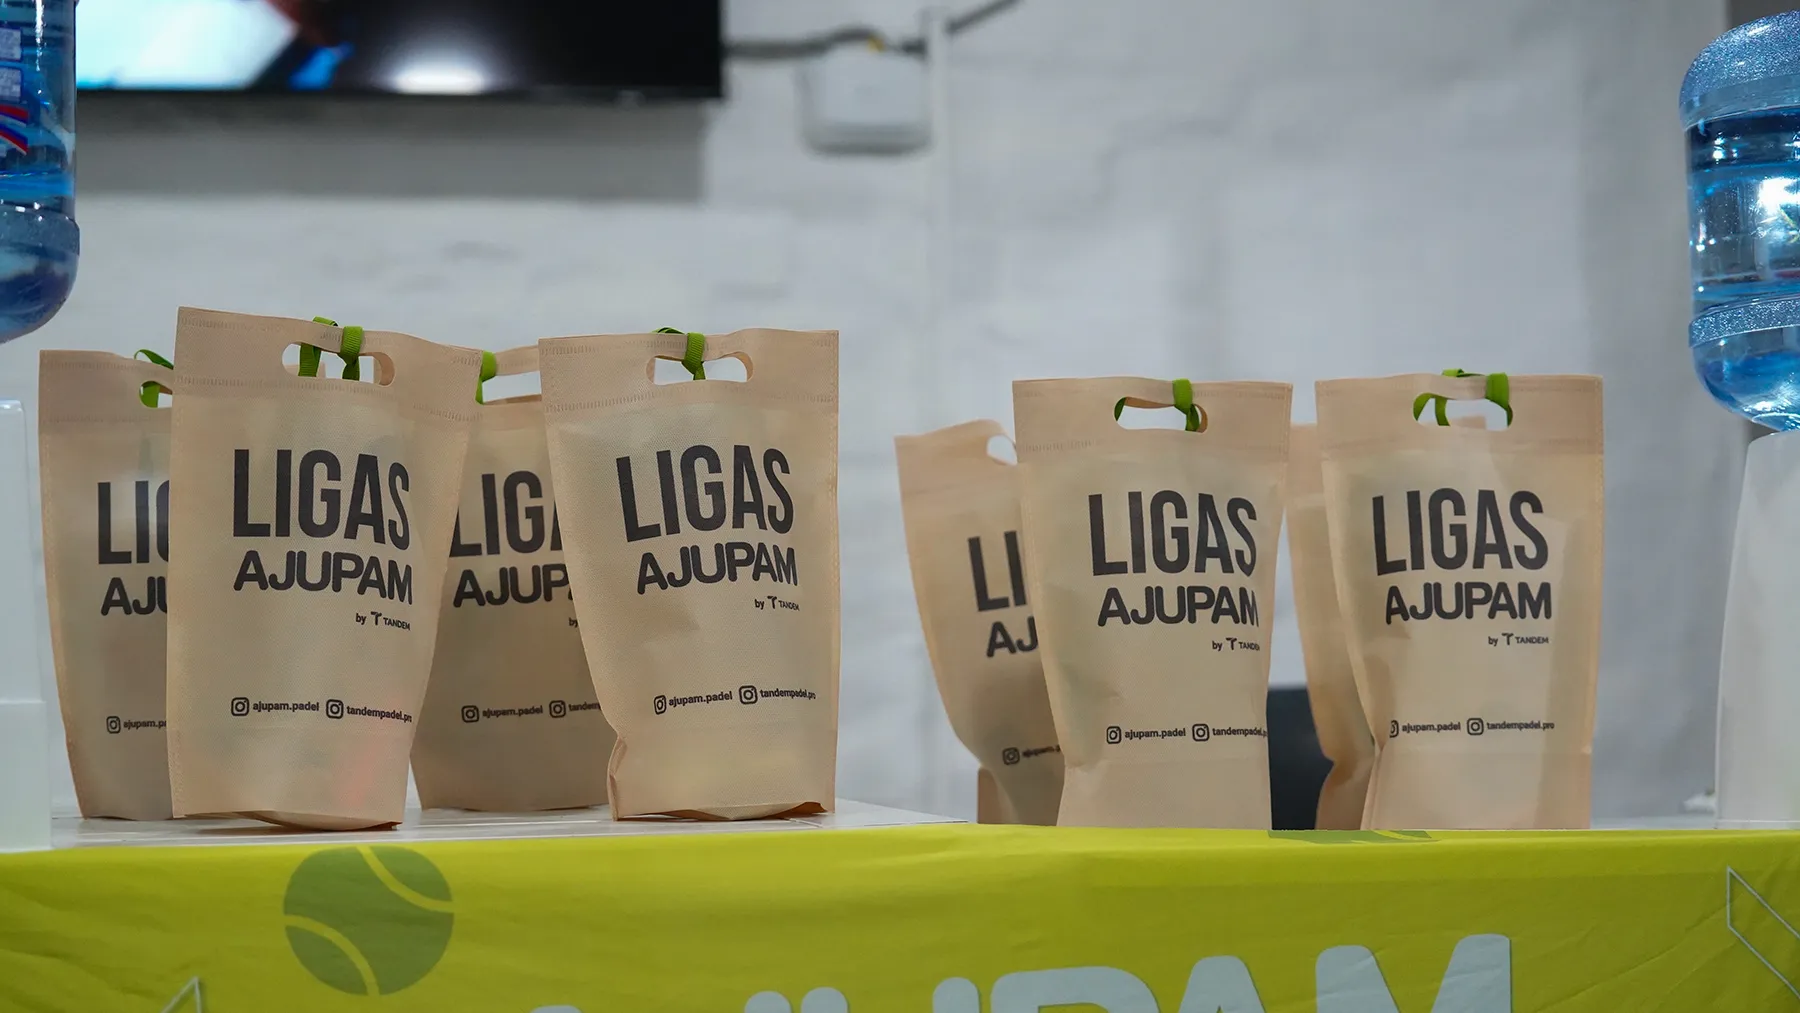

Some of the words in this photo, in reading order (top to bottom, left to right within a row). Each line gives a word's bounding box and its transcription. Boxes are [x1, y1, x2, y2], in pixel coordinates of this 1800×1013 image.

[233, 448, 411, 550] LIGAS
[449, 470, 563, 558] LIG
[616, 444, 794, 543] LIGAS
[1088, 490, 1258, 577] LIGAS
[1372, 487, 1549, 576] LIGAS
[233, 549, 413, 605] AJUPAM
[453, 563, 573, 608] AJUP
[637, 541, 798, 594] AJUPAM
[356, 612, 367, 625] by
[383, 617, 411, 631] TANDEM
[755, 598, 765, 610] by
[778, 600, 800, 611] TANDEM
[1098, 585, 1260, 627] AJUPAM
[1386, 580, 1552, 625] AJUPAM
[986, 615, 1038, 658] AJ
[1212, 641, 1222, 651] by
[1488, 636, 1498, 646] by
[1516, 636, 1549, 644] TANDEM
[252, 701, 319, 712] ajupam.padel
[482, 705, 543, 718] ajupam.padel
[568, 700, 601, 712] tandem
[668, 690, 733, 707] ajupam.padel
[1124, 728, 1186, 740] ajupam.padel
[1402, 722, 1461, 733] ajupam.padel
[1487, 721, 1554, 731] tandempadel.pro
